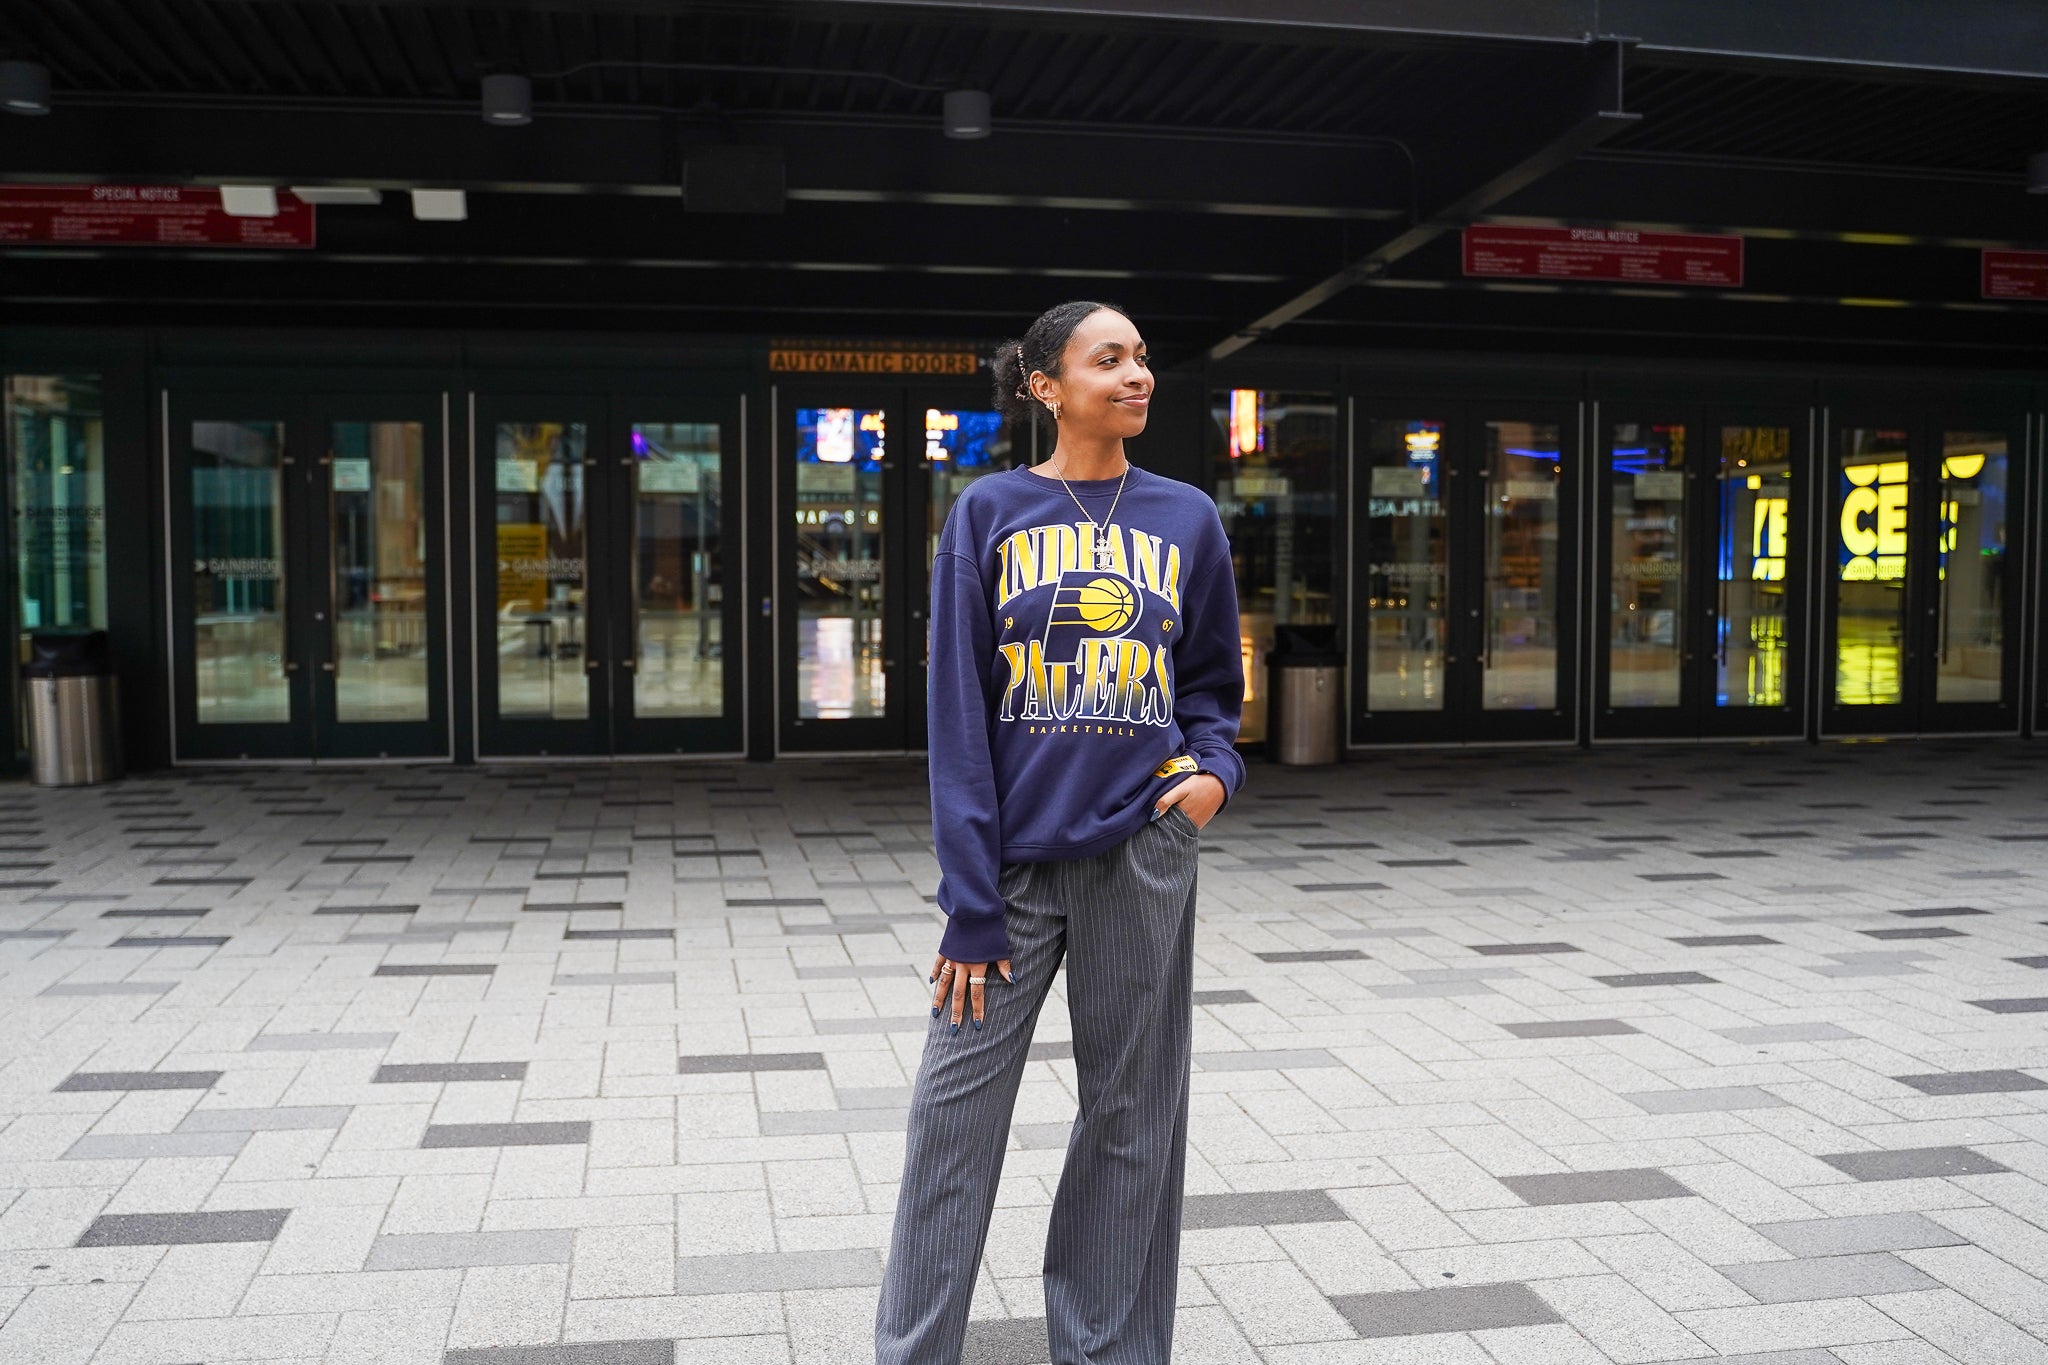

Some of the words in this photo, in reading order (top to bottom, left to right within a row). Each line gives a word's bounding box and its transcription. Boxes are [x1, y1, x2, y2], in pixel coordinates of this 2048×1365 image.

[92, 186, 136, 201] SPECIAL
[139, 187, 181, 201] NOTICE
[1570, 228, 1606, 242] SPECIAL
[1607, 230, 1640, 243] NOTICE
[774, 353, 894, 371] AUTOMATIC
[901, 355, 970, 371] DOORS
[997, 521, 1181, 615] INDIANA
[1004, 616, 1014, 630] 19
[999, 638, 1173, 727] PACERS
[1029, 725, 1135, 737] BASKETBALL
